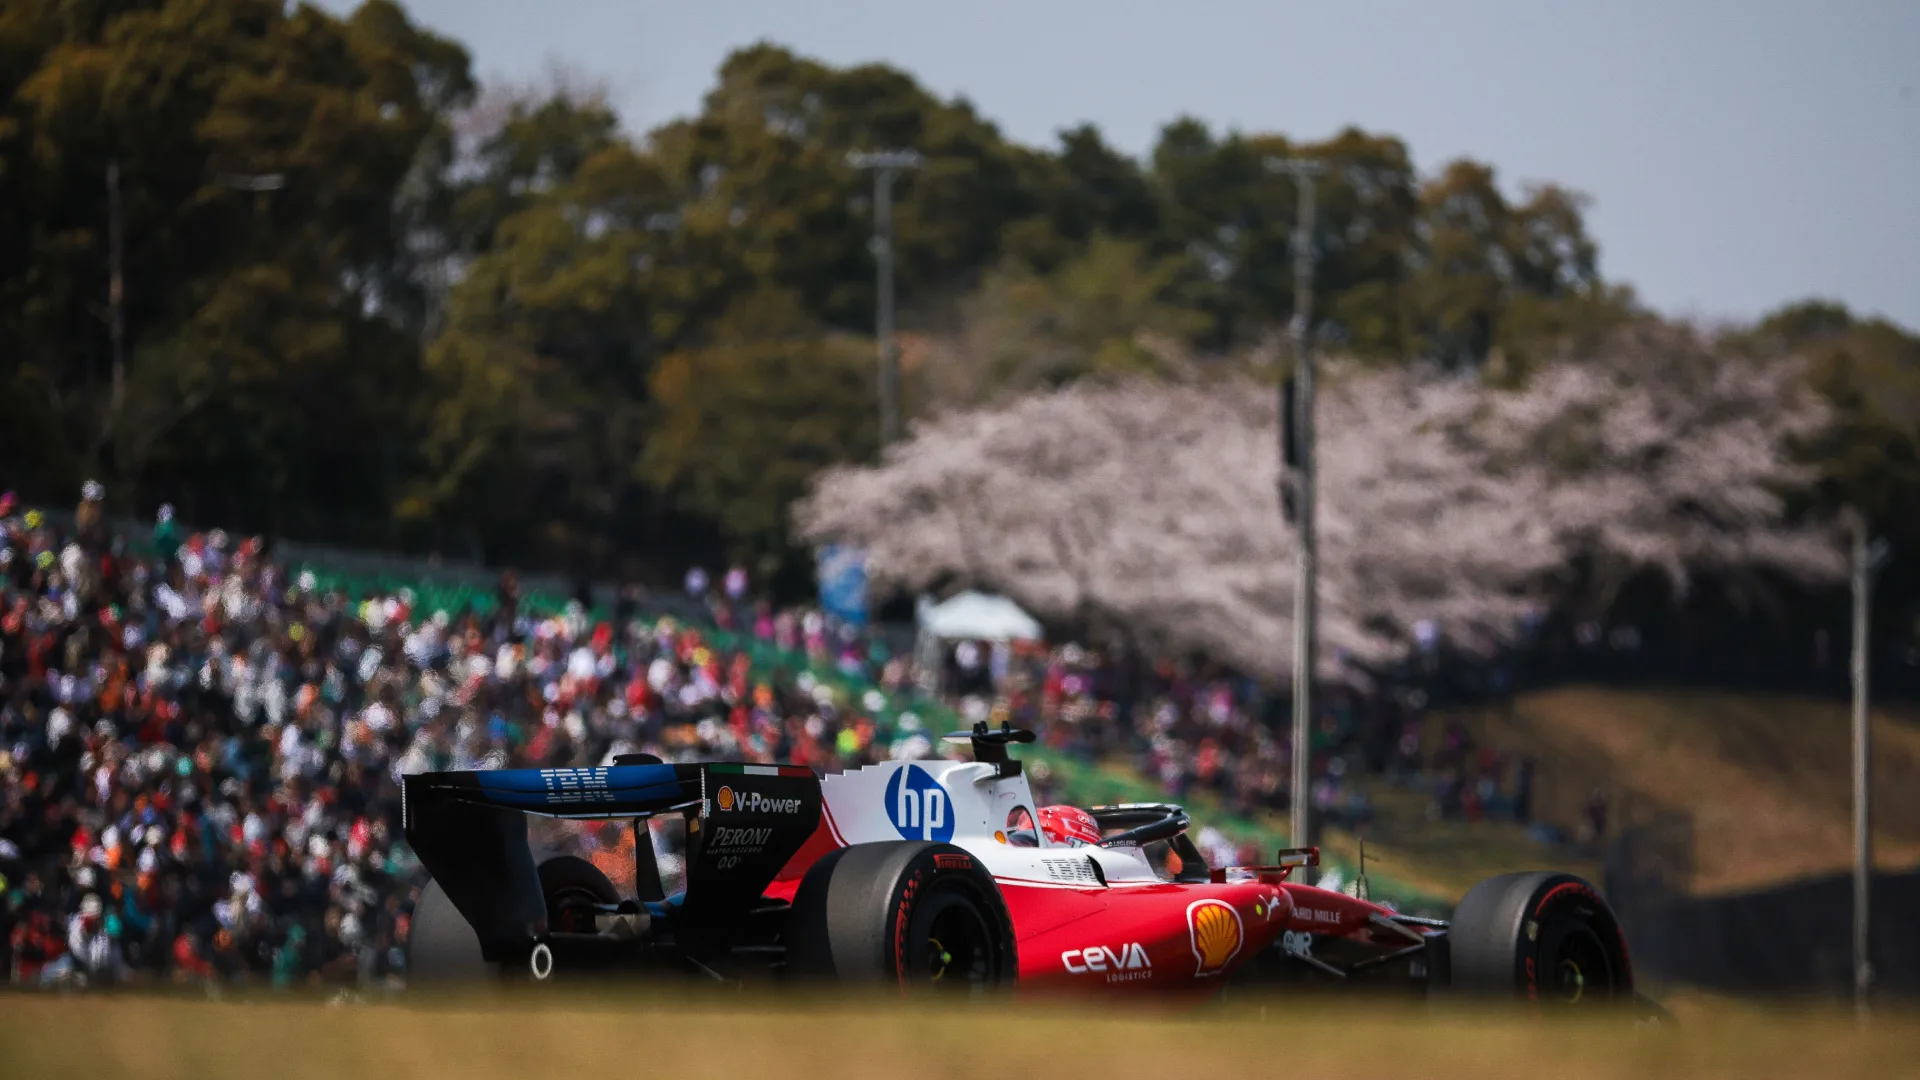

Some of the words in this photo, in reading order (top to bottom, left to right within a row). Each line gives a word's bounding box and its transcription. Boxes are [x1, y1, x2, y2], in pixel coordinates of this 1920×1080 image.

[540, 767, 616, 803] IBM
[734, 791, 802, 814] V-Power
[898, 764, 945, 841] hp
[709, 826, 773, 847] PERONI
[933, 853, 972, 869] PIRELLI
[1292, 907, 1312, 921] ARD
[1314, 909, 1341, 924] MILLE
[1107, 972, 1152, 983] LOGISTICS
